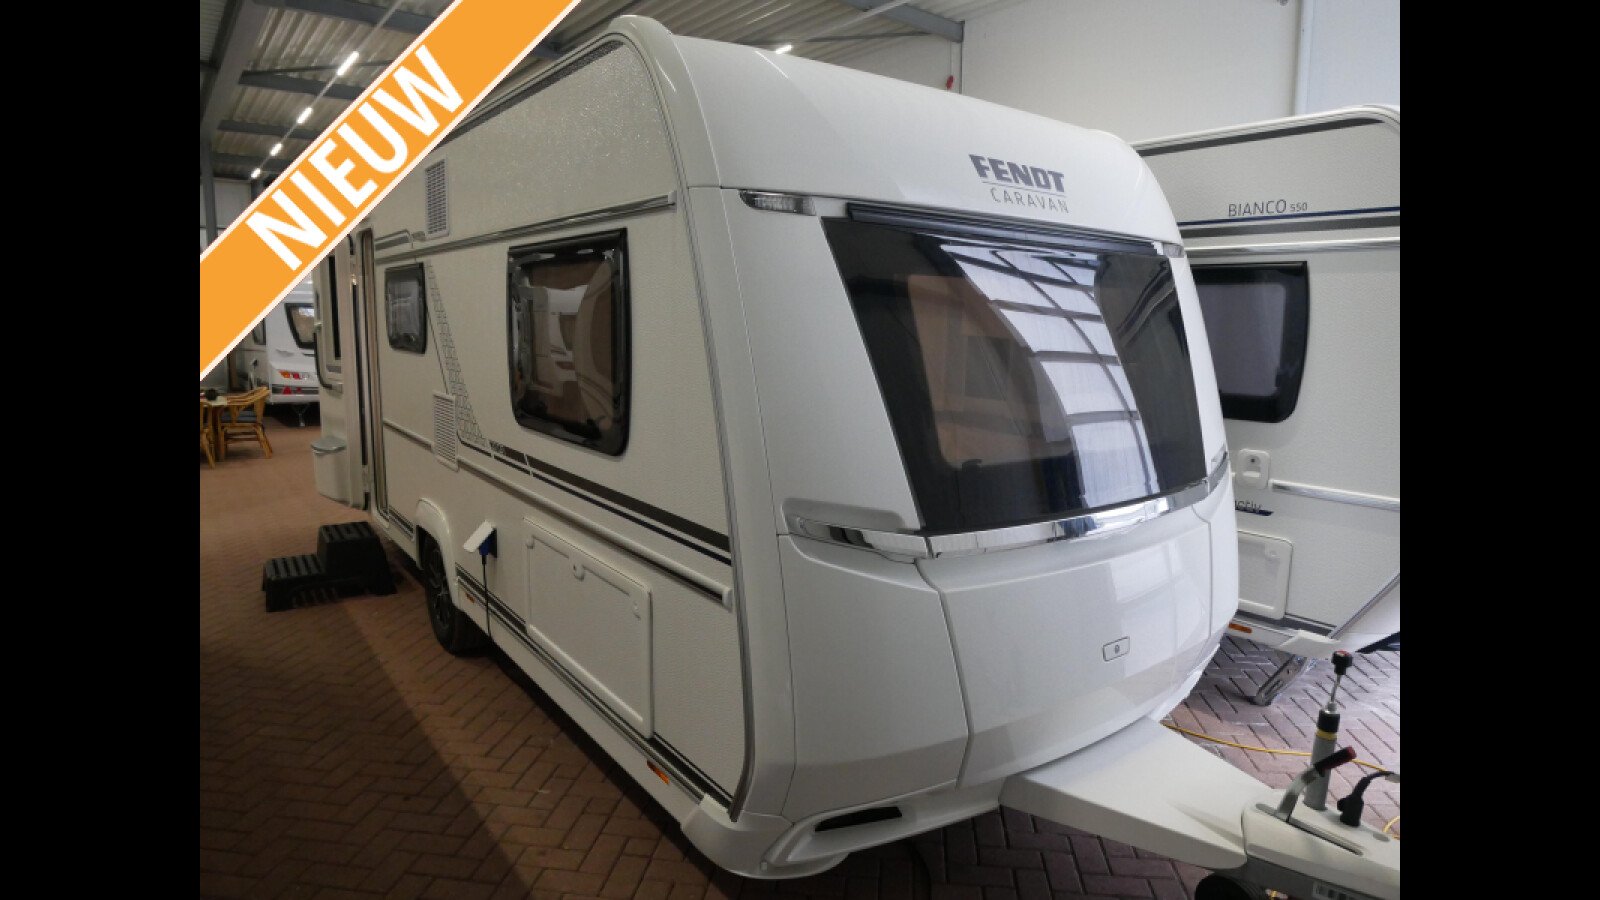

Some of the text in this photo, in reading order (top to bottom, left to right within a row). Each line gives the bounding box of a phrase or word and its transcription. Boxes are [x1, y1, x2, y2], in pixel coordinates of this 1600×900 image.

[968, 153, 1065, 193] FENDT
[989, 187, 1069, 214] CARAVAN
[1228, 199, 1308, 217] BIANCO 550
